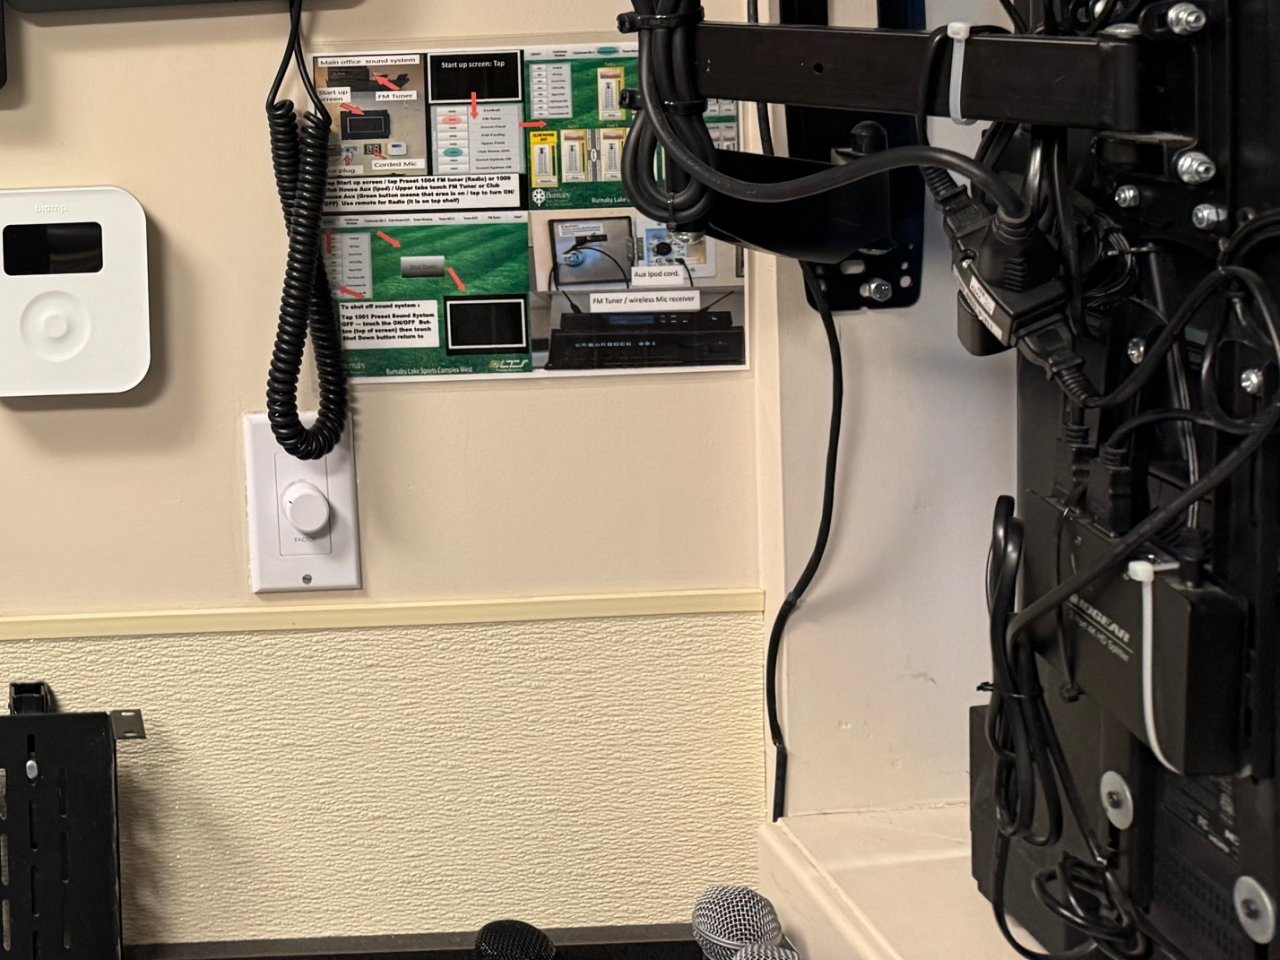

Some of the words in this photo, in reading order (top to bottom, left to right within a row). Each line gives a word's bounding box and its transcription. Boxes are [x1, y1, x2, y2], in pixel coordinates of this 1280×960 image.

[390, 57, 416, 65] system
[469, 60, 492, 68] screen:
[493, 60, 505, 69] Tap
[648, 270, 660, 279] Ipod
[629, 296, 654, 304] wireless
[421, 367, 437, 375] Sports
[461, 366, 472, 374] West
